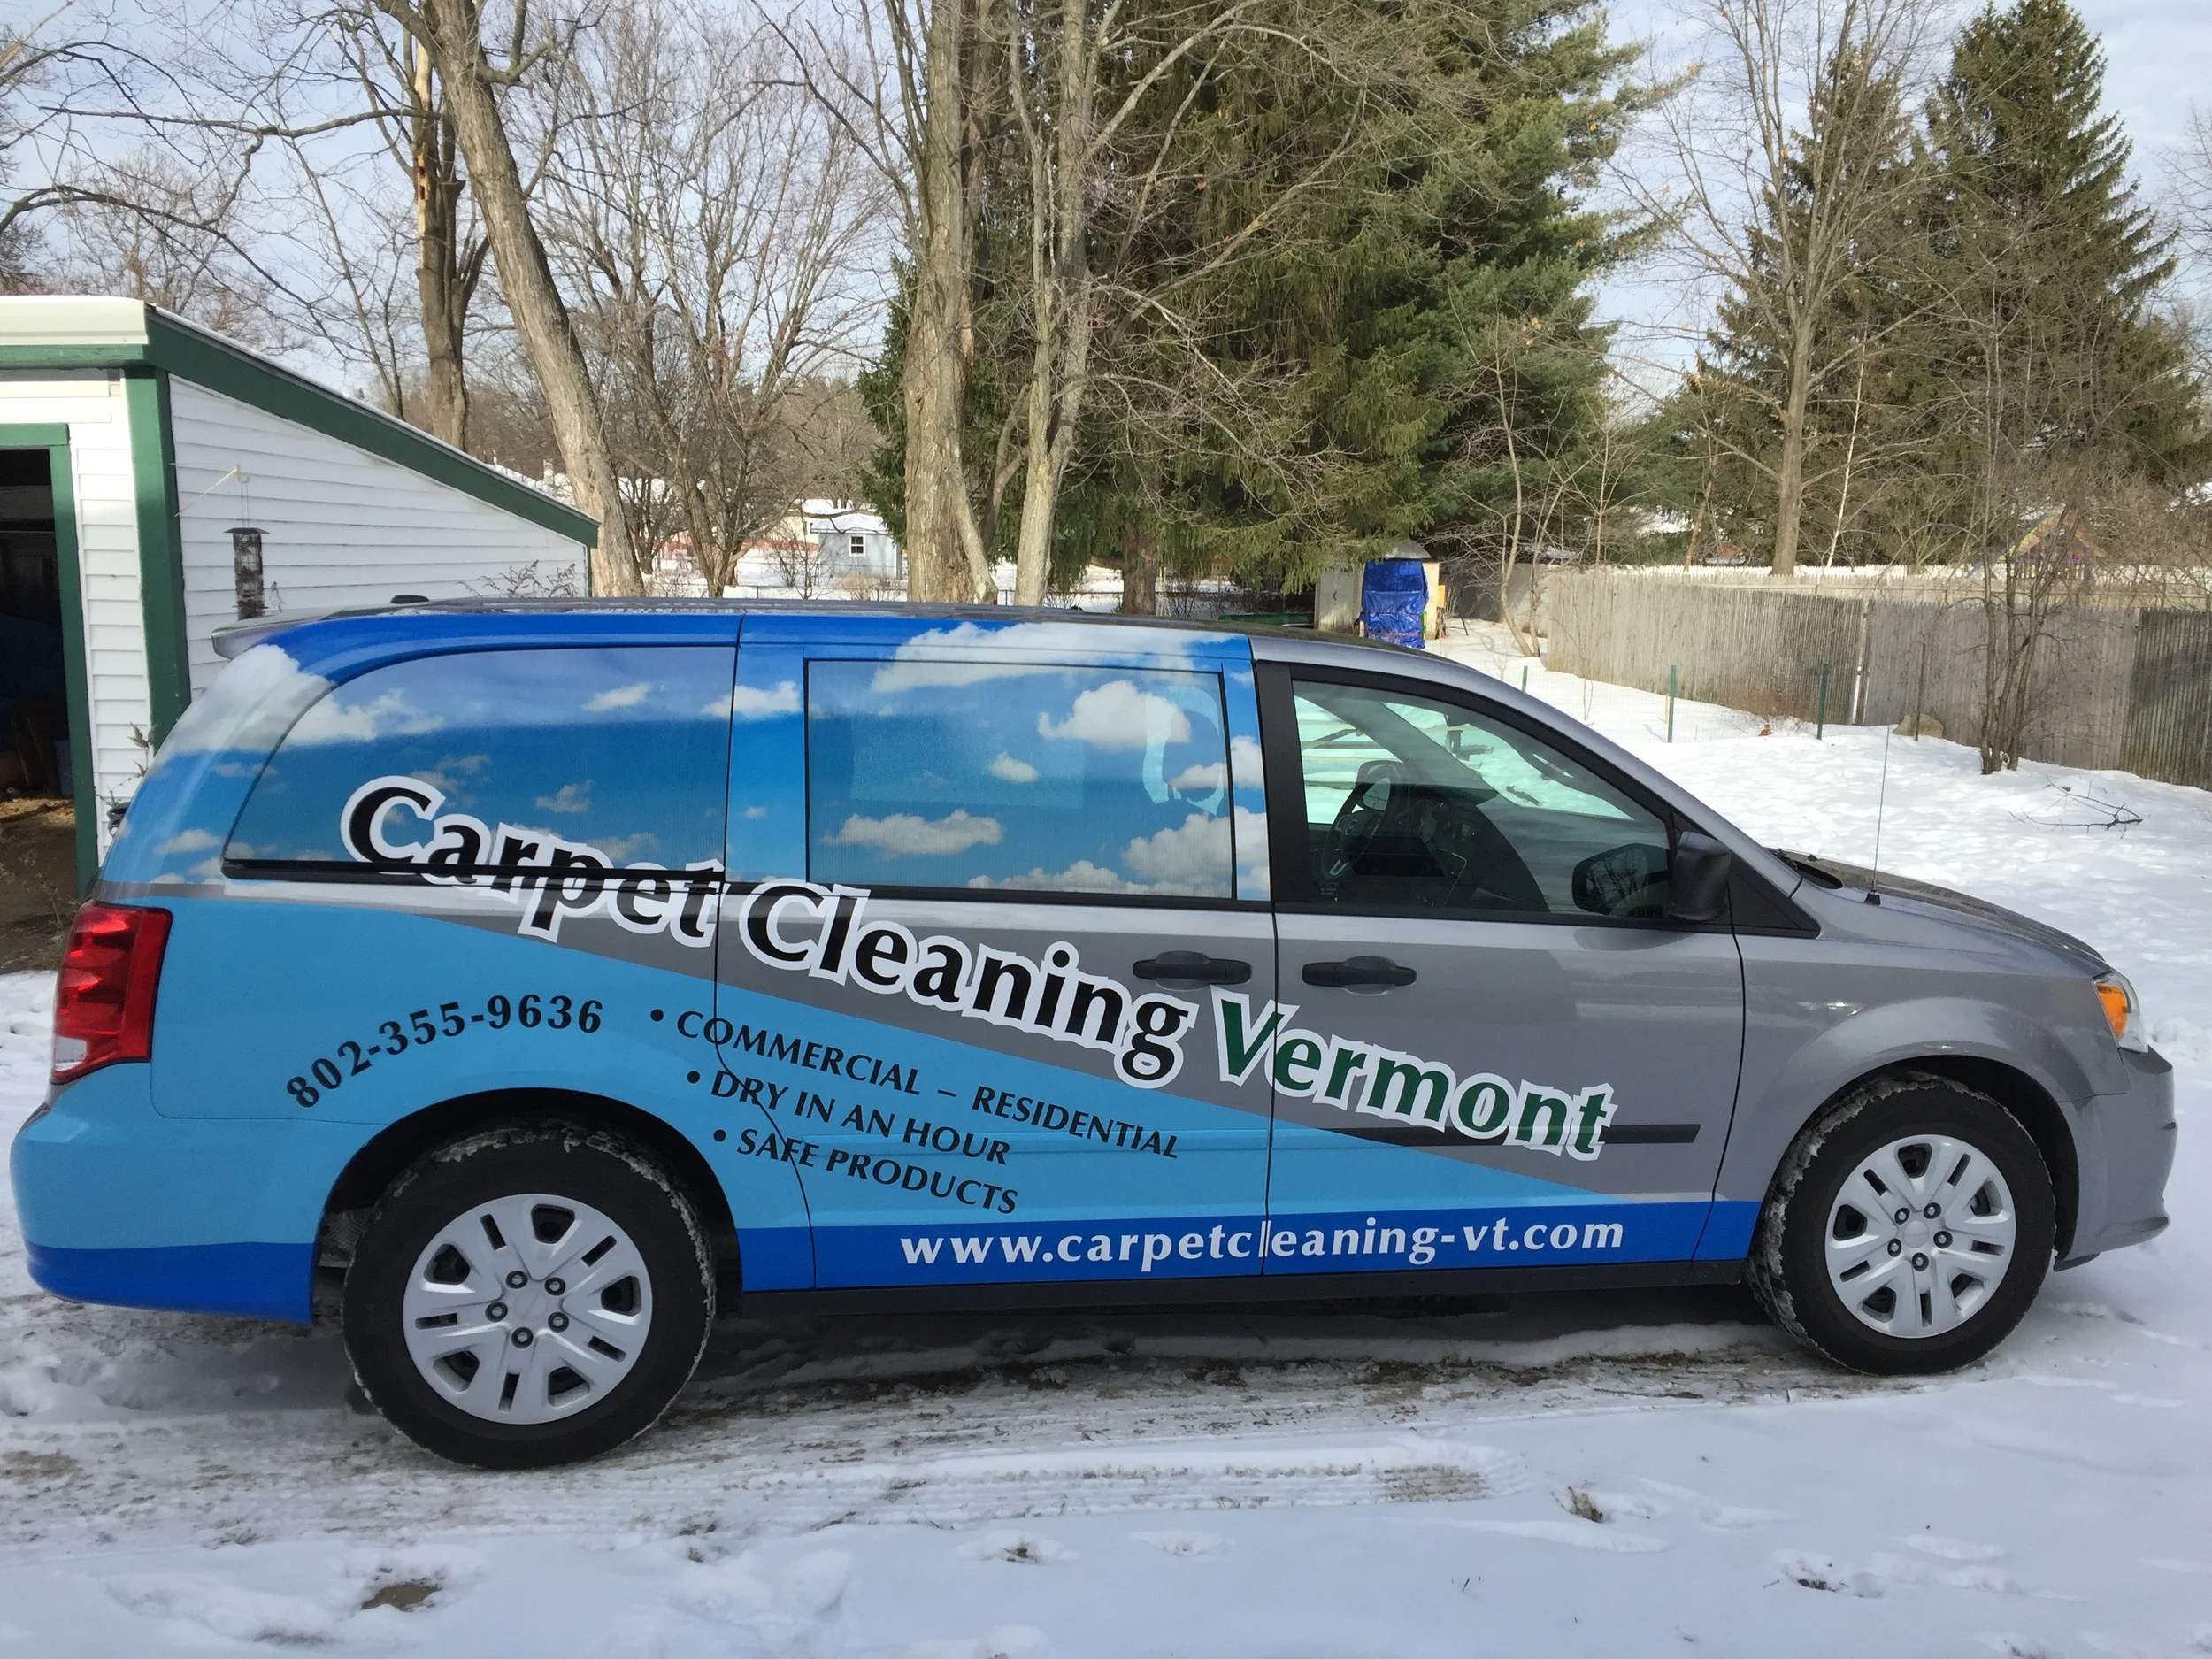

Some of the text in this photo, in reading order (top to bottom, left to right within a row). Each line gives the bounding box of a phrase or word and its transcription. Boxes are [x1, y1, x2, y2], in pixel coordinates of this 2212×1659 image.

[341, 776, 1618, 1161] Carpet Cleaning Vermont
[286, 994, 603, 1108] 802-355-9636
[676, 1010, 920, 1095] COMMERCIAL
[972, 1086, 1179, 1159] RESIDENTIAL
[710, 1071, 1010, 1165] DRY IN AN HOUR
[737, 1128, 1019, 1214] SAFE PRODUCTS
[900, 1217, 1624, 1273] www.carpetcleaning-vt.com
